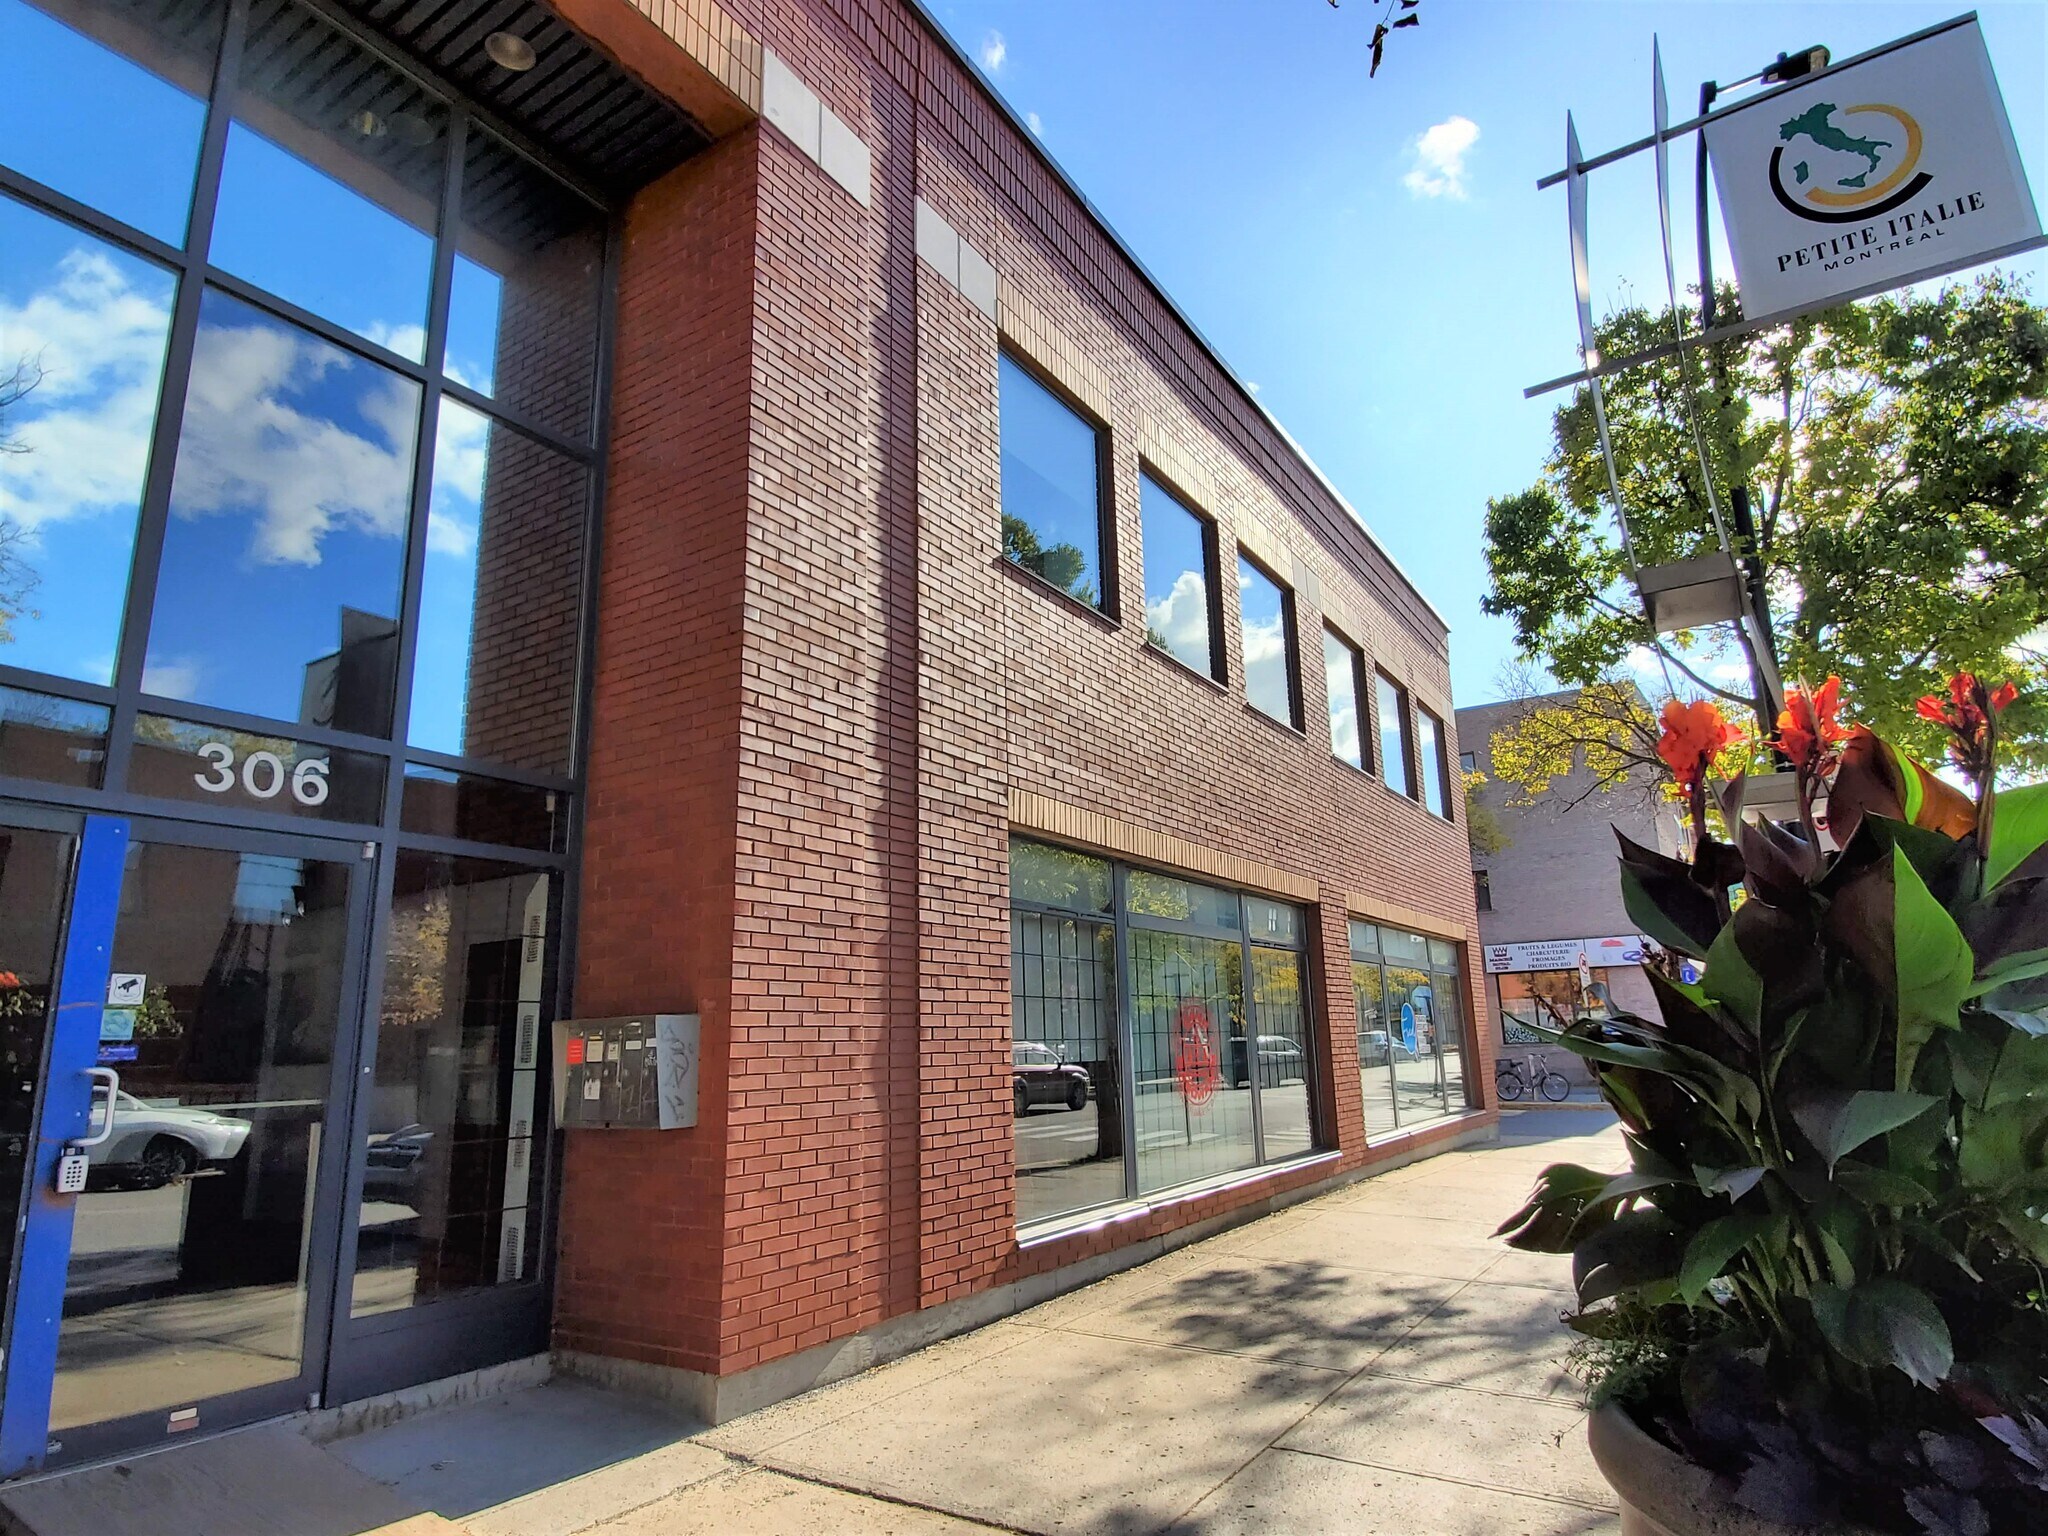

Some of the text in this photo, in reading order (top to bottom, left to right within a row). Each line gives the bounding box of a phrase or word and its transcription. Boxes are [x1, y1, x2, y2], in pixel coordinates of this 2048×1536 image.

[1777, 191, 1985, 273] PETITE ITALIE
[1823, 229, 1946, 272] MONTRÉAL
[194, 742, 330, 806] 306
[1526, 949, 1570, 957] CHARCUTERIE
